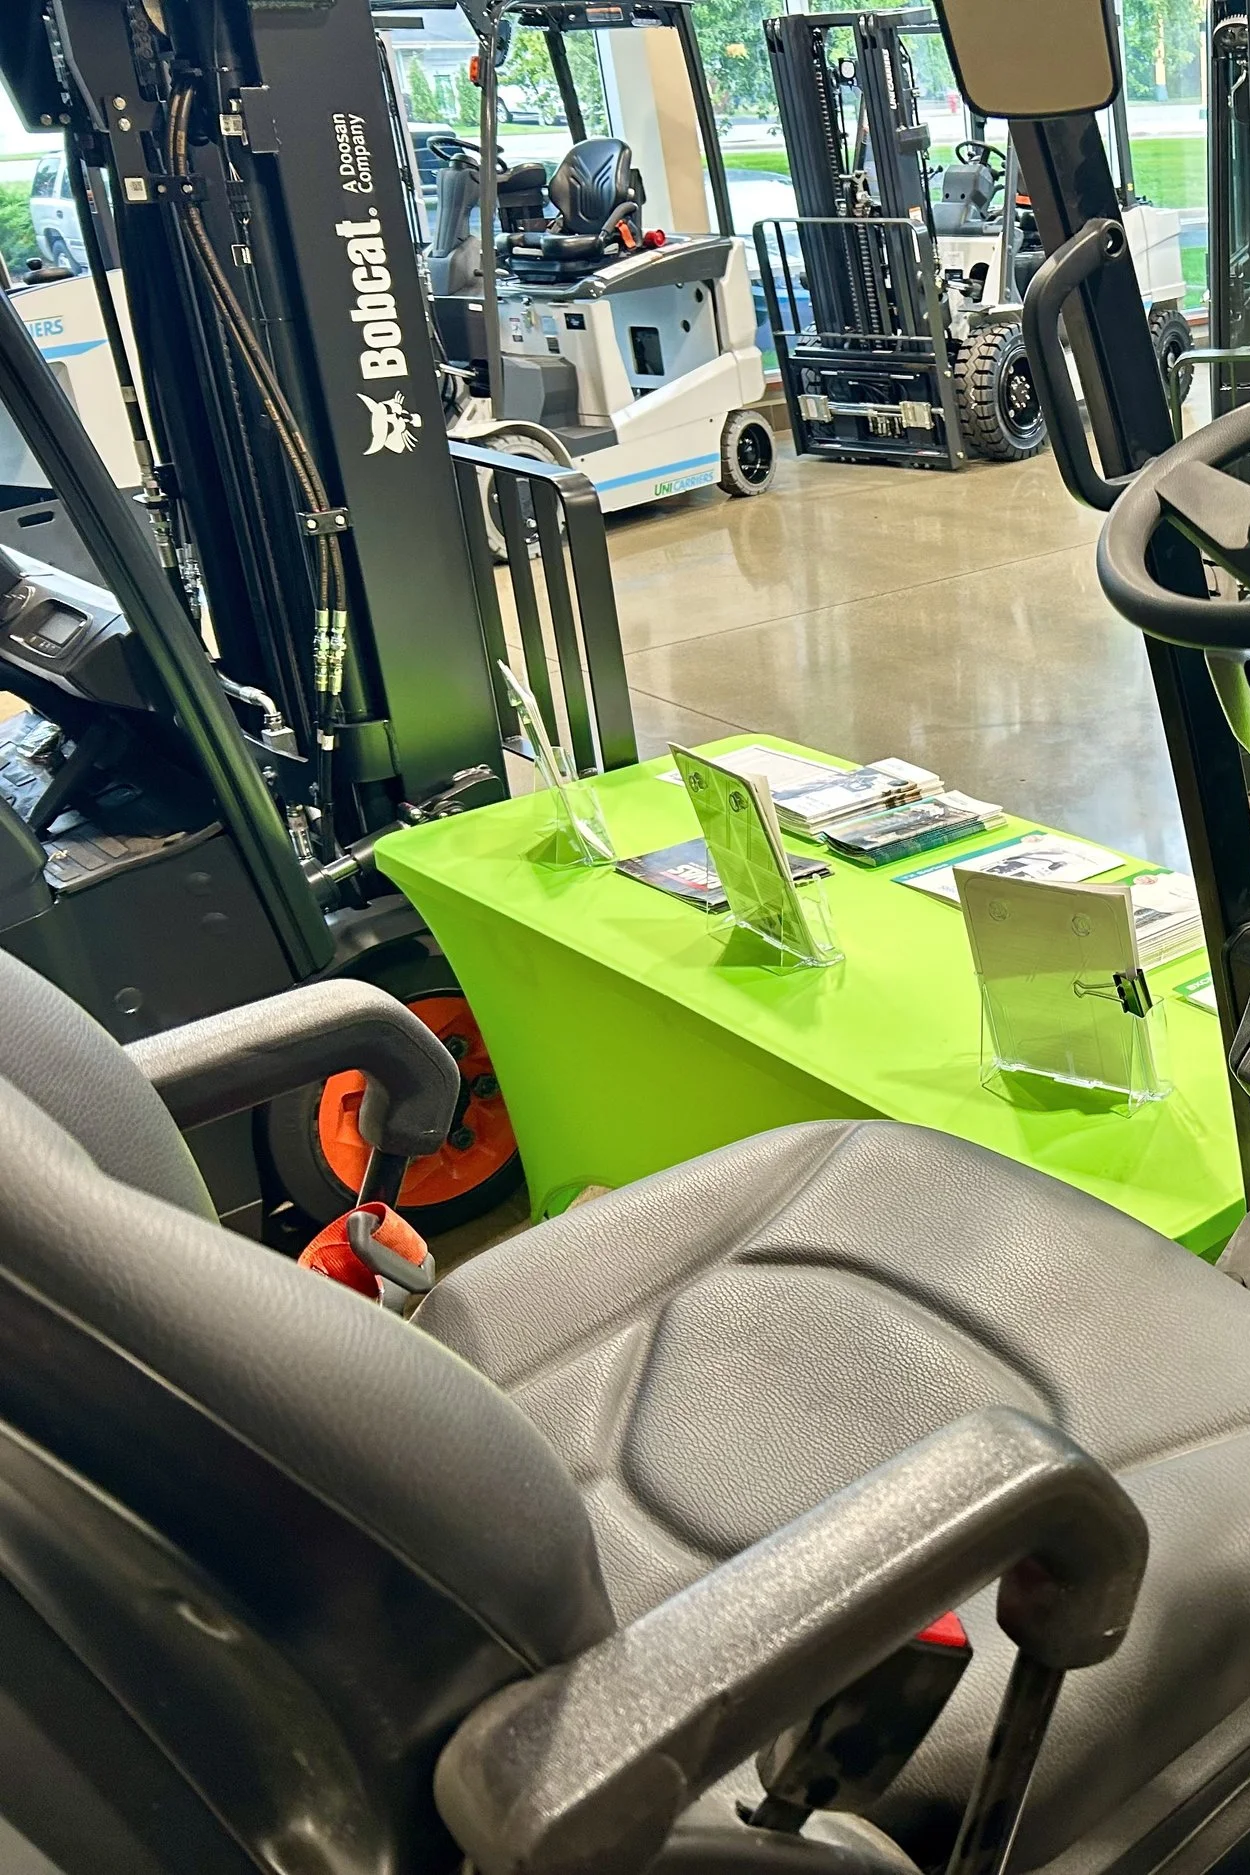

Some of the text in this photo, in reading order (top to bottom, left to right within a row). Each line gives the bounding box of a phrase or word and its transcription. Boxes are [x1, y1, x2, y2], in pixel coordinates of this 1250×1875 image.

[332, 113, 359, 194] A Doosan
[348, 113, 374, 194] Company
[335, 219, 408, 380] Bobcat
